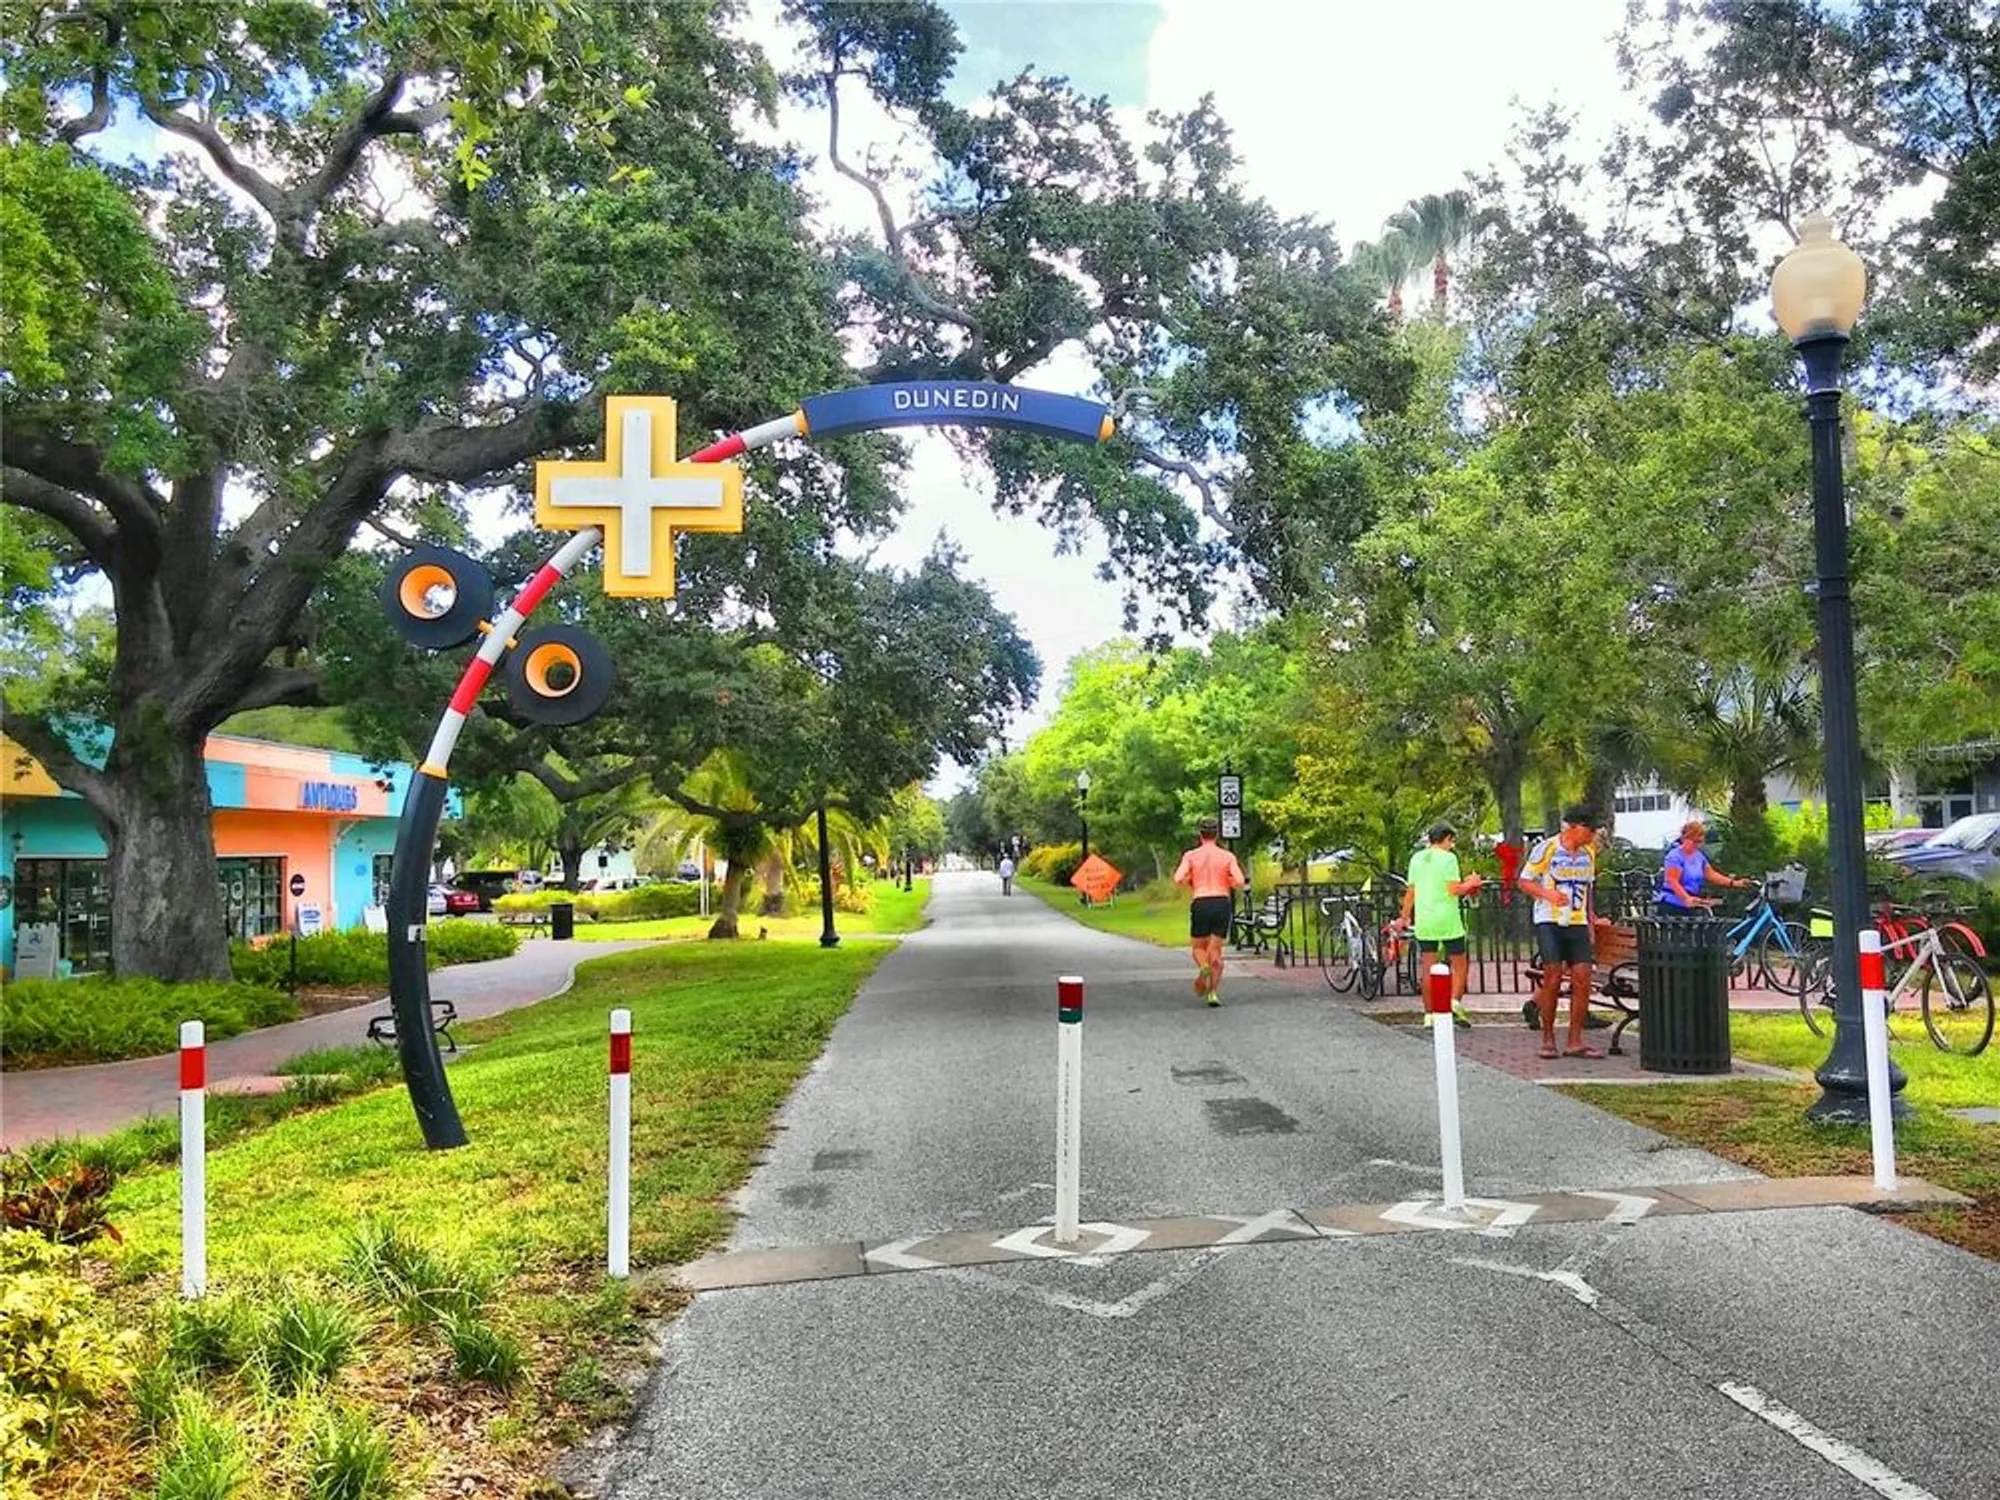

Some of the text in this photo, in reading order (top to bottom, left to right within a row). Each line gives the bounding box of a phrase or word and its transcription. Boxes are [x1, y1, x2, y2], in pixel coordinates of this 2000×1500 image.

[895, 389, 1019, 411] DUNEDIN
[304, 781, 357, 810] ANTIQUES
[1224, 790, 1238, 803] 20
